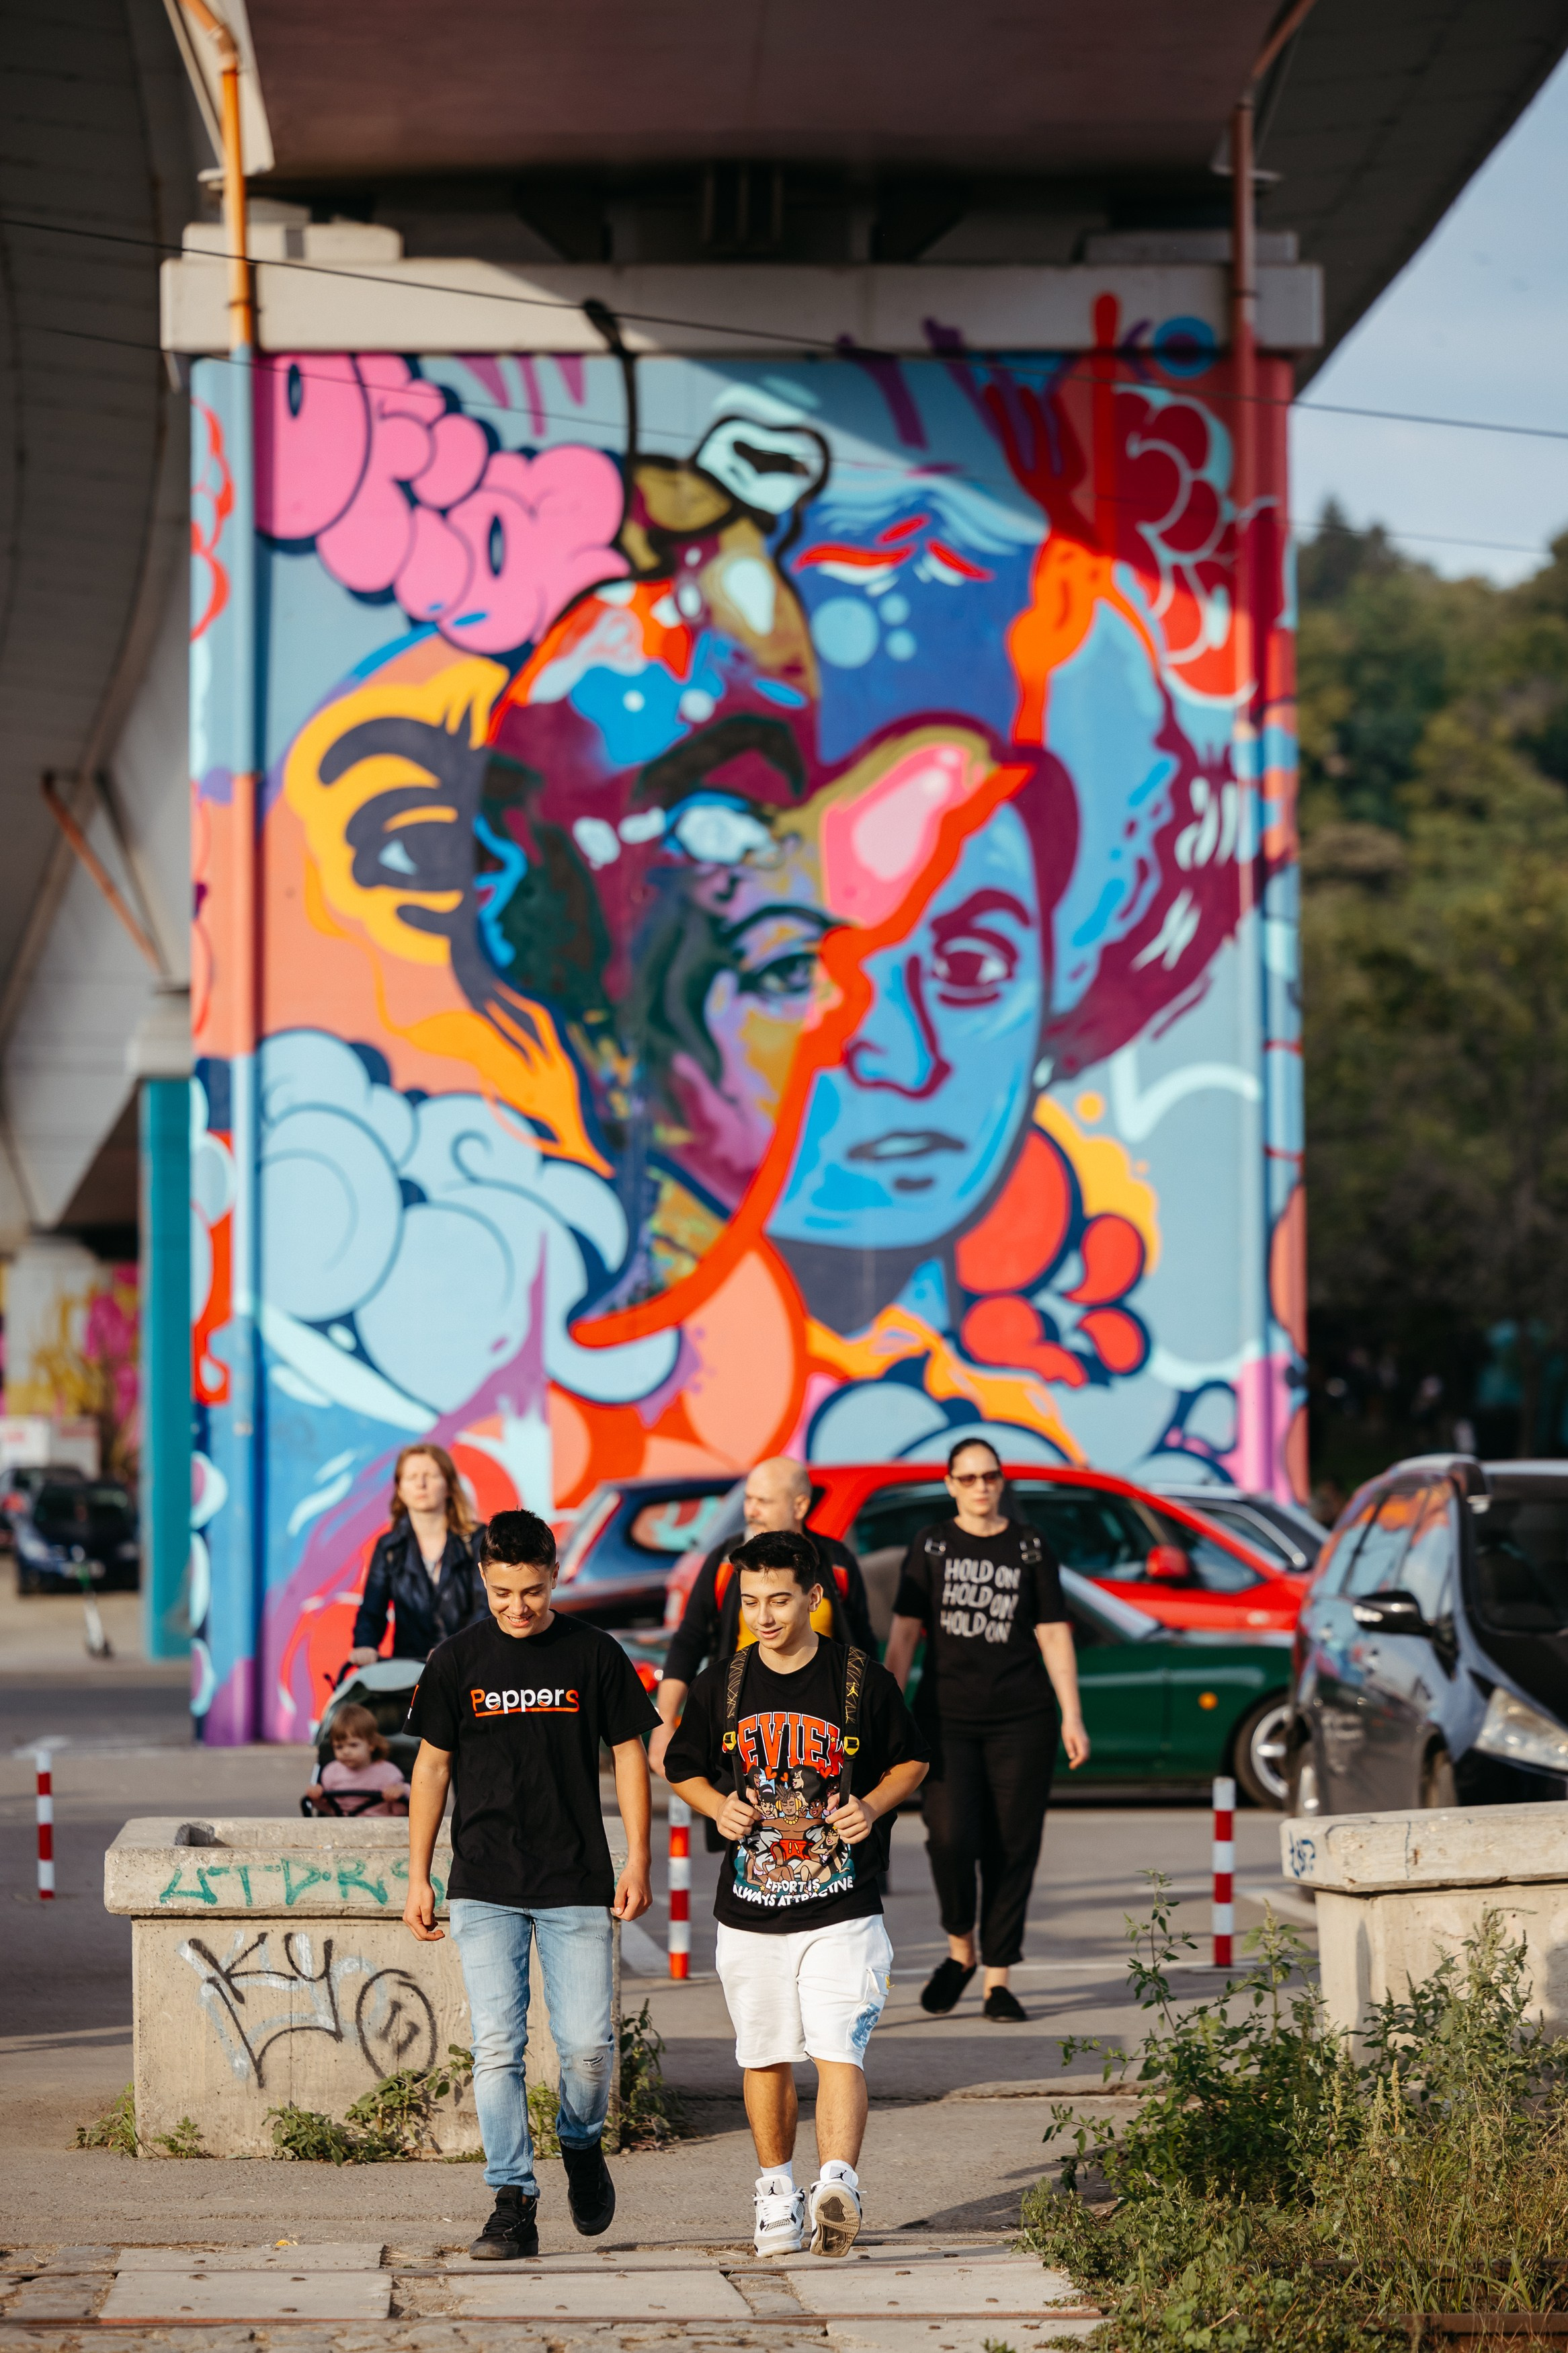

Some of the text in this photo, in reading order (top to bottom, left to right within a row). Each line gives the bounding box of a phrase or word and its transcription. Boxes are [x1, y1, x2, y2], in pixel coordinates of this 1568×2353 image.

[944, 1558, 1021, 1589] HOLD ON
[942, 1582, 1019, 1620] HOLD ON
[940, 1610, 1012, 1644] HOLD ON
[470, 1688, 579, 1717] Peppers
[733, 1884, 777, 1907] ALWAYS
[766, 1878, 821, 1893] EFFORT IS
